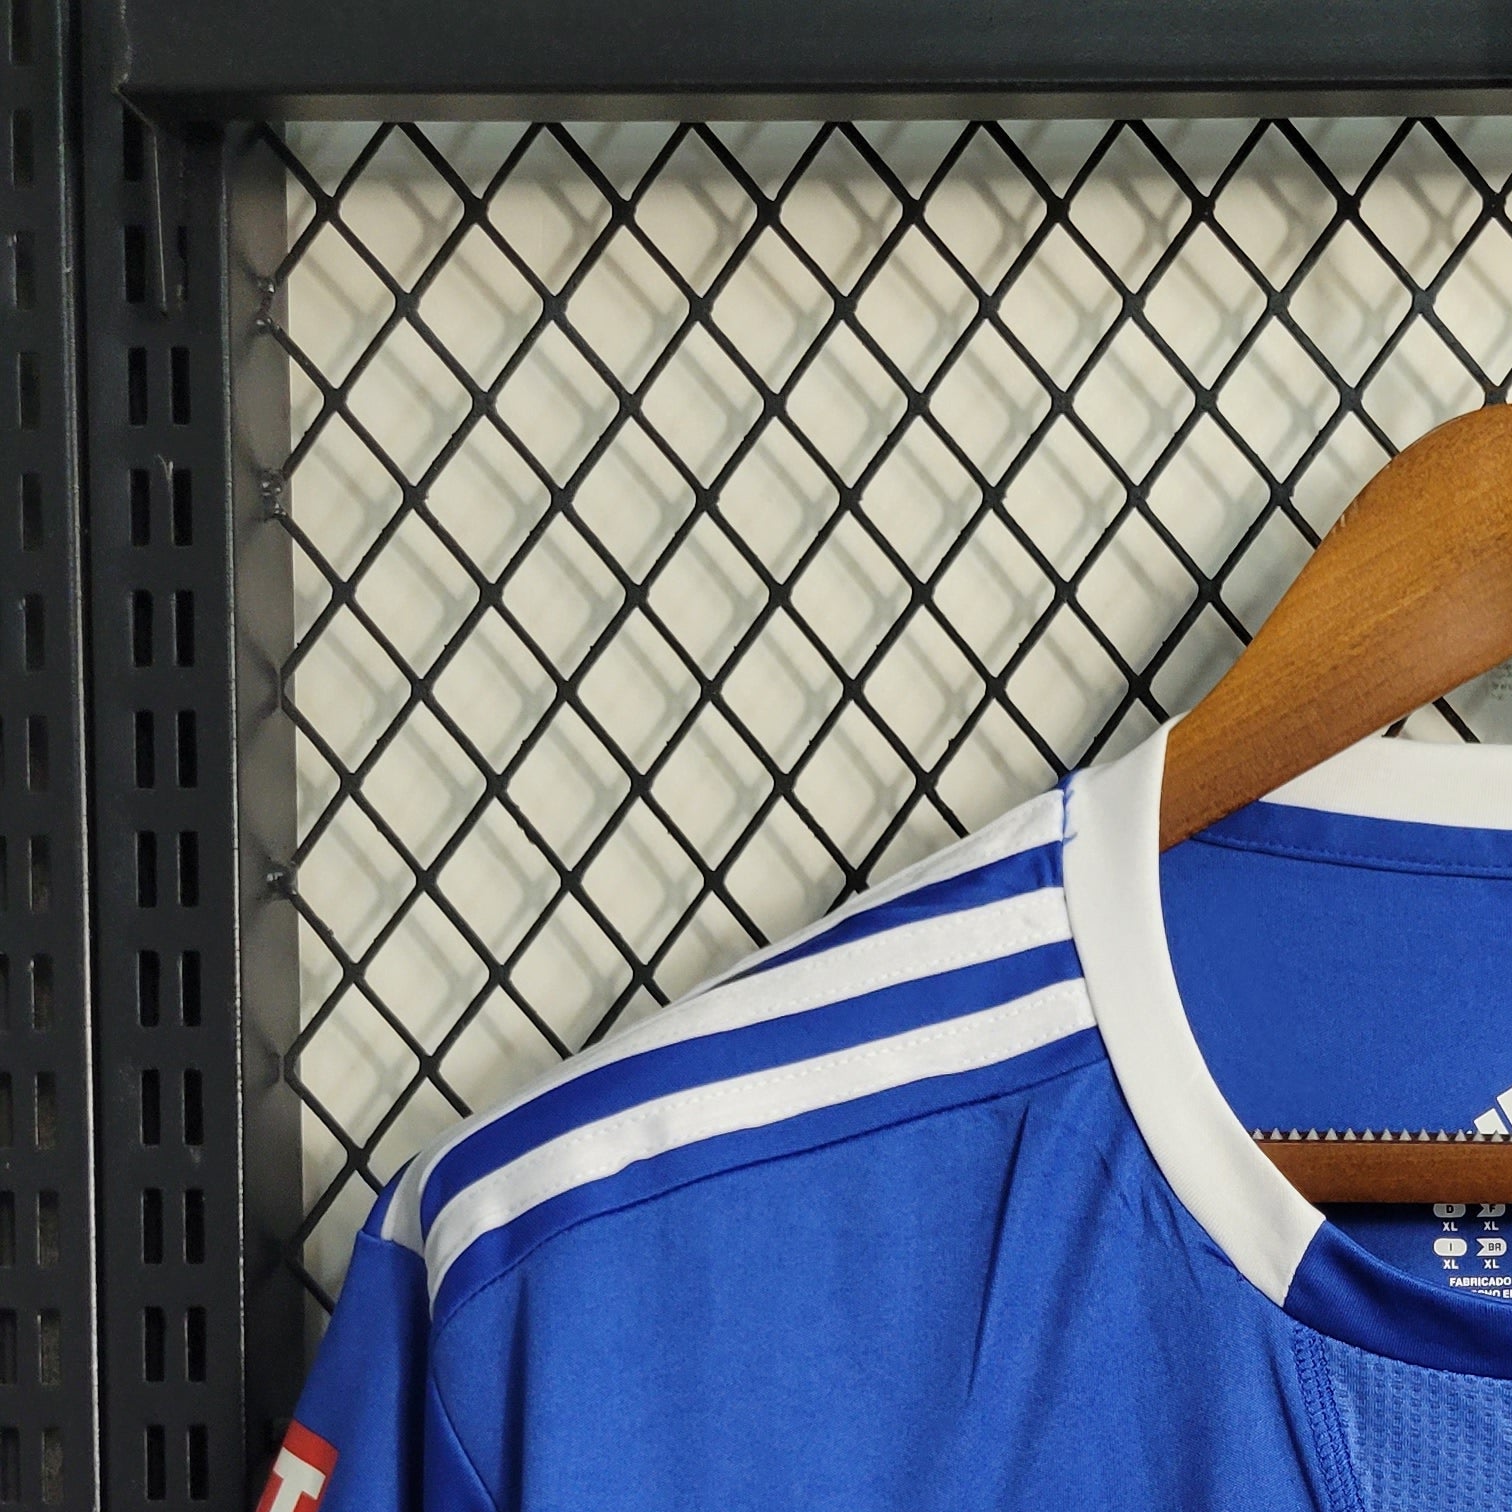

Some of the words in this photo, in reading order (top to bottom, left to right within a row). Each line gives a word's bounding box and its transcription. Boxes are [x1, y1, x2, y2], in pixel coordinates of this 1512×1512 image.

[1446, 1204, 1454, 1214] D
[1489, 1204, 1496, 1213] F
[1442, 1221, 1458, 1231] XL
[1483, 1221, 1499, 1231] XL
[1488, 1242, 1502, 1251] BR
[1443, 1259, 1459, 1269] XL
[1484, 1259, 1500, 1269] XL
[1449, 1277, 1511, 1287] FABRICADO
